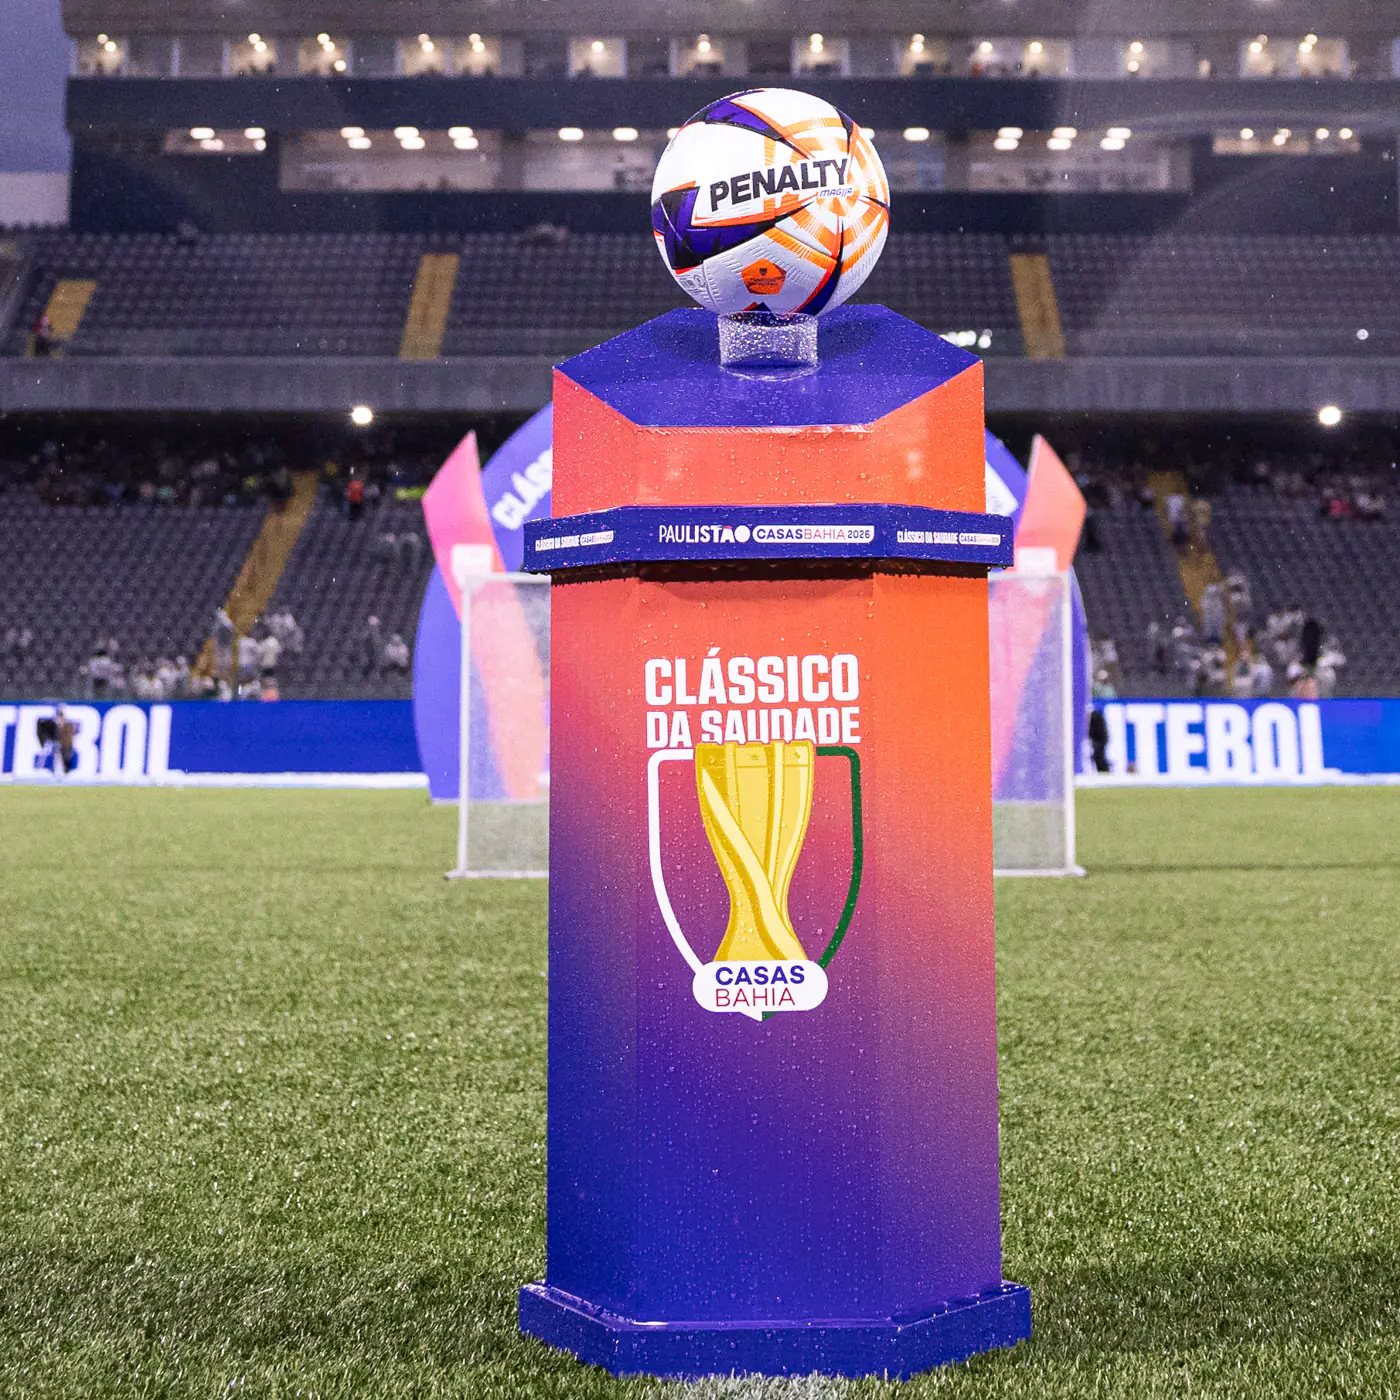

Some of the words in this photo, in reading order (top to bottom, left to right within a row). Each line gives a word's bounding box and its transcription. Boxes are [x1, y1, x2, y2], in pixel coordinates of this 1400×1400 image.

[710, 158, 848, 212] PENALTY
[659, 525, 750, 543] PAULISTÃO
[847, 529, 871, 539] 2026
[644, 647, 860, 706] CLÁSSICO
[646, 711, 693, 749] DA
[701, 706, 862, 745] SAUDADE
[715, 965, 806, 985] CASAS
[715, 987, 795, 1007] BAHIA
